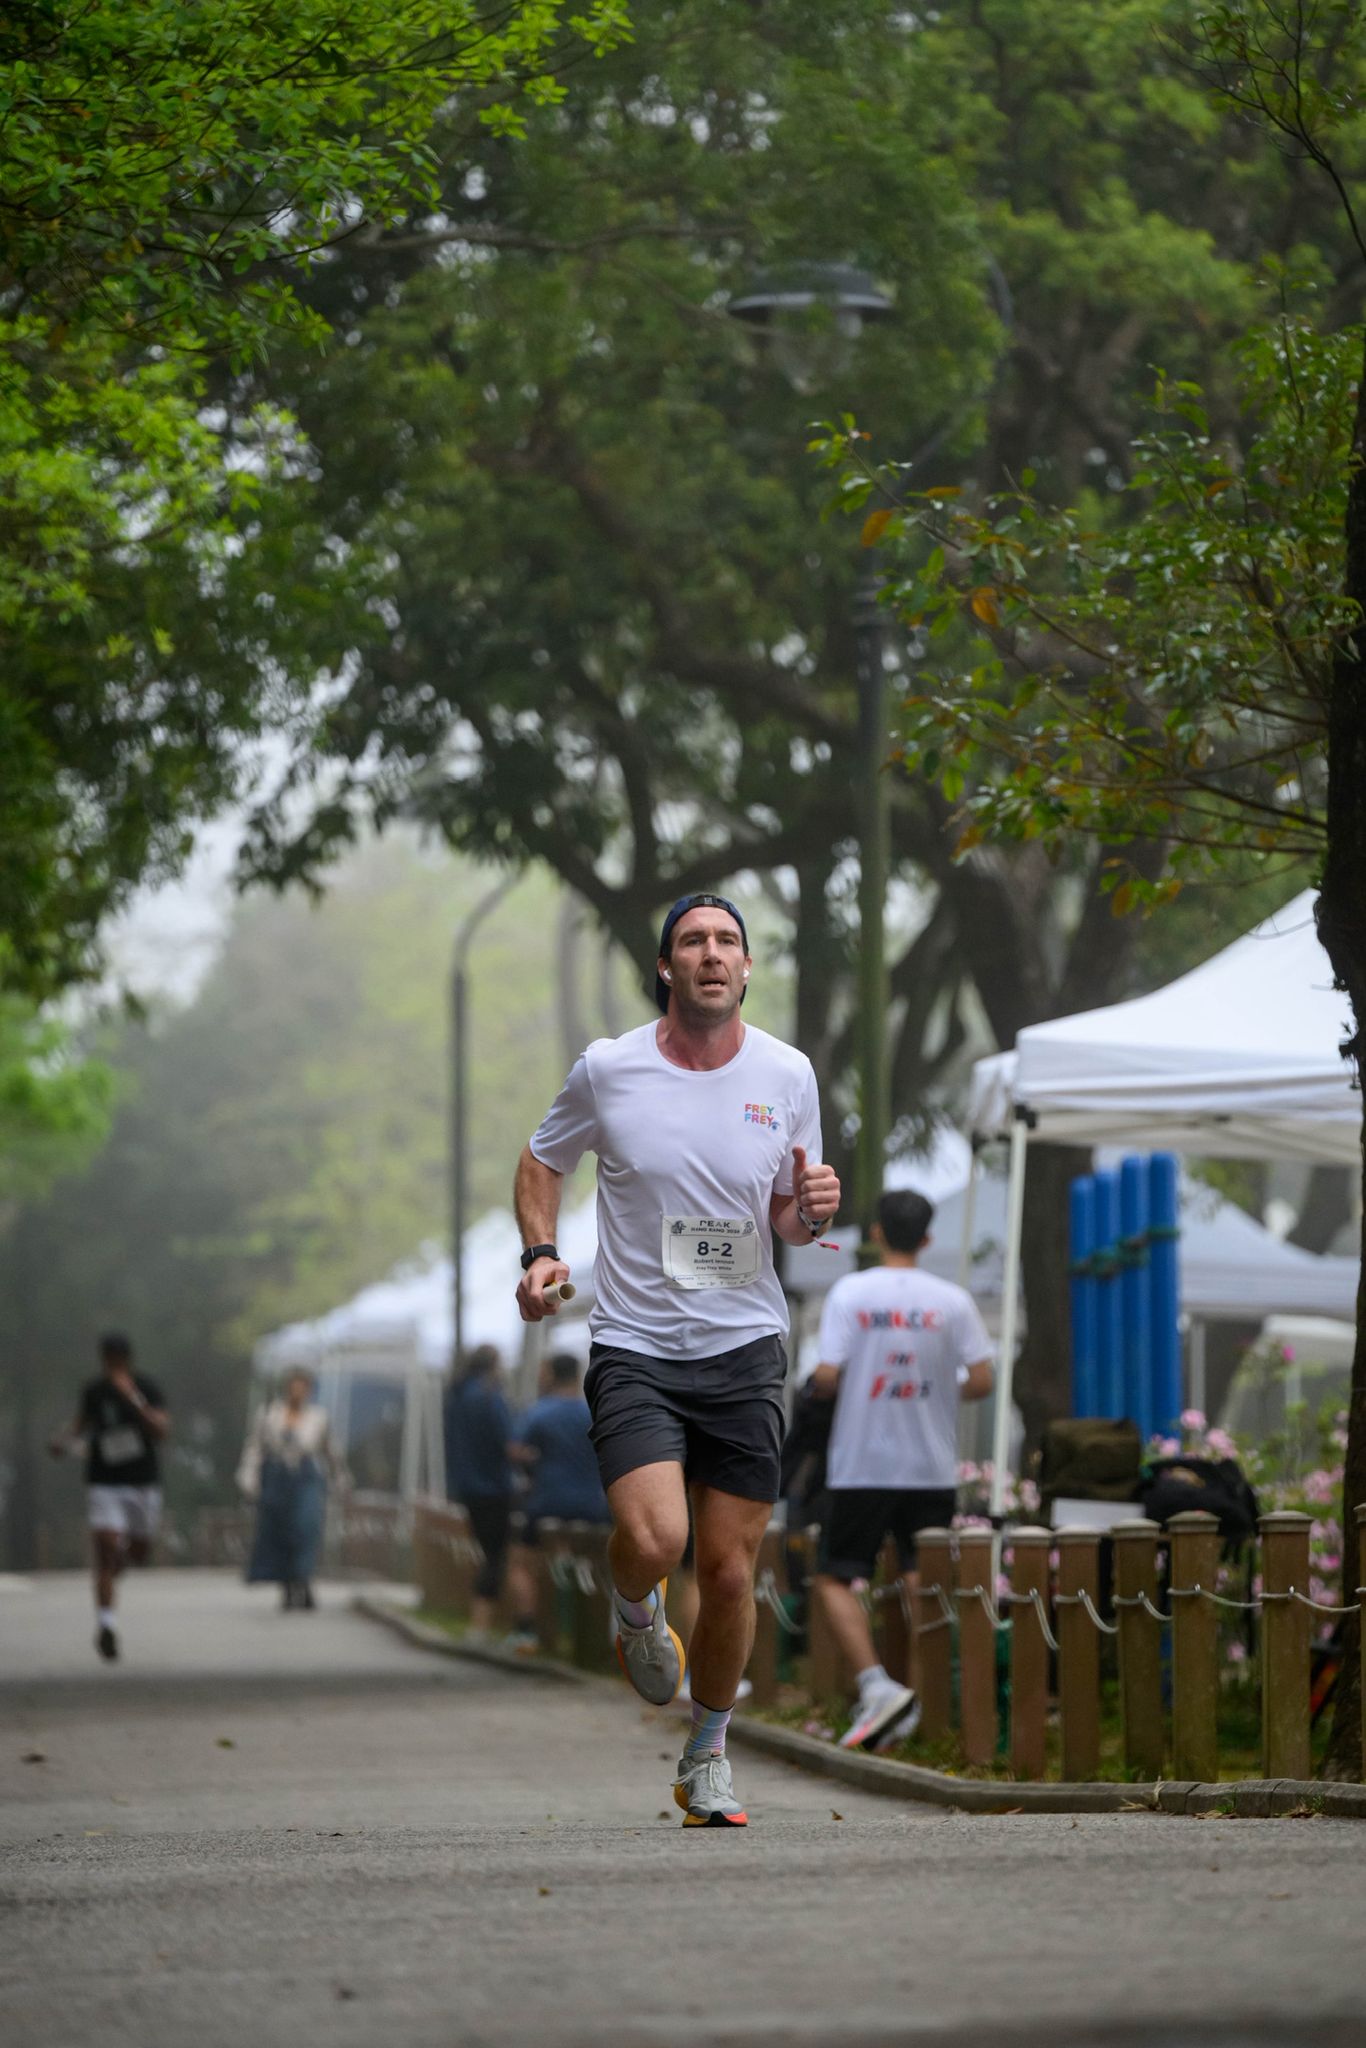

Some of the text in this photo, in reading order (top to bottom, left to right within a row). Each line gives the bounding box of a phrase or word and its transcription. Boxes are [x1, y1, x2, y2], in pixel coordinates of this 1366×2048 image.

[745, 1103, 774, 1115] FREY
[744, 1113, 774, 1128] FREY
[699, 1220, 730, 1228] PEAK
[697, 1241, 733, 1257] 8-2
